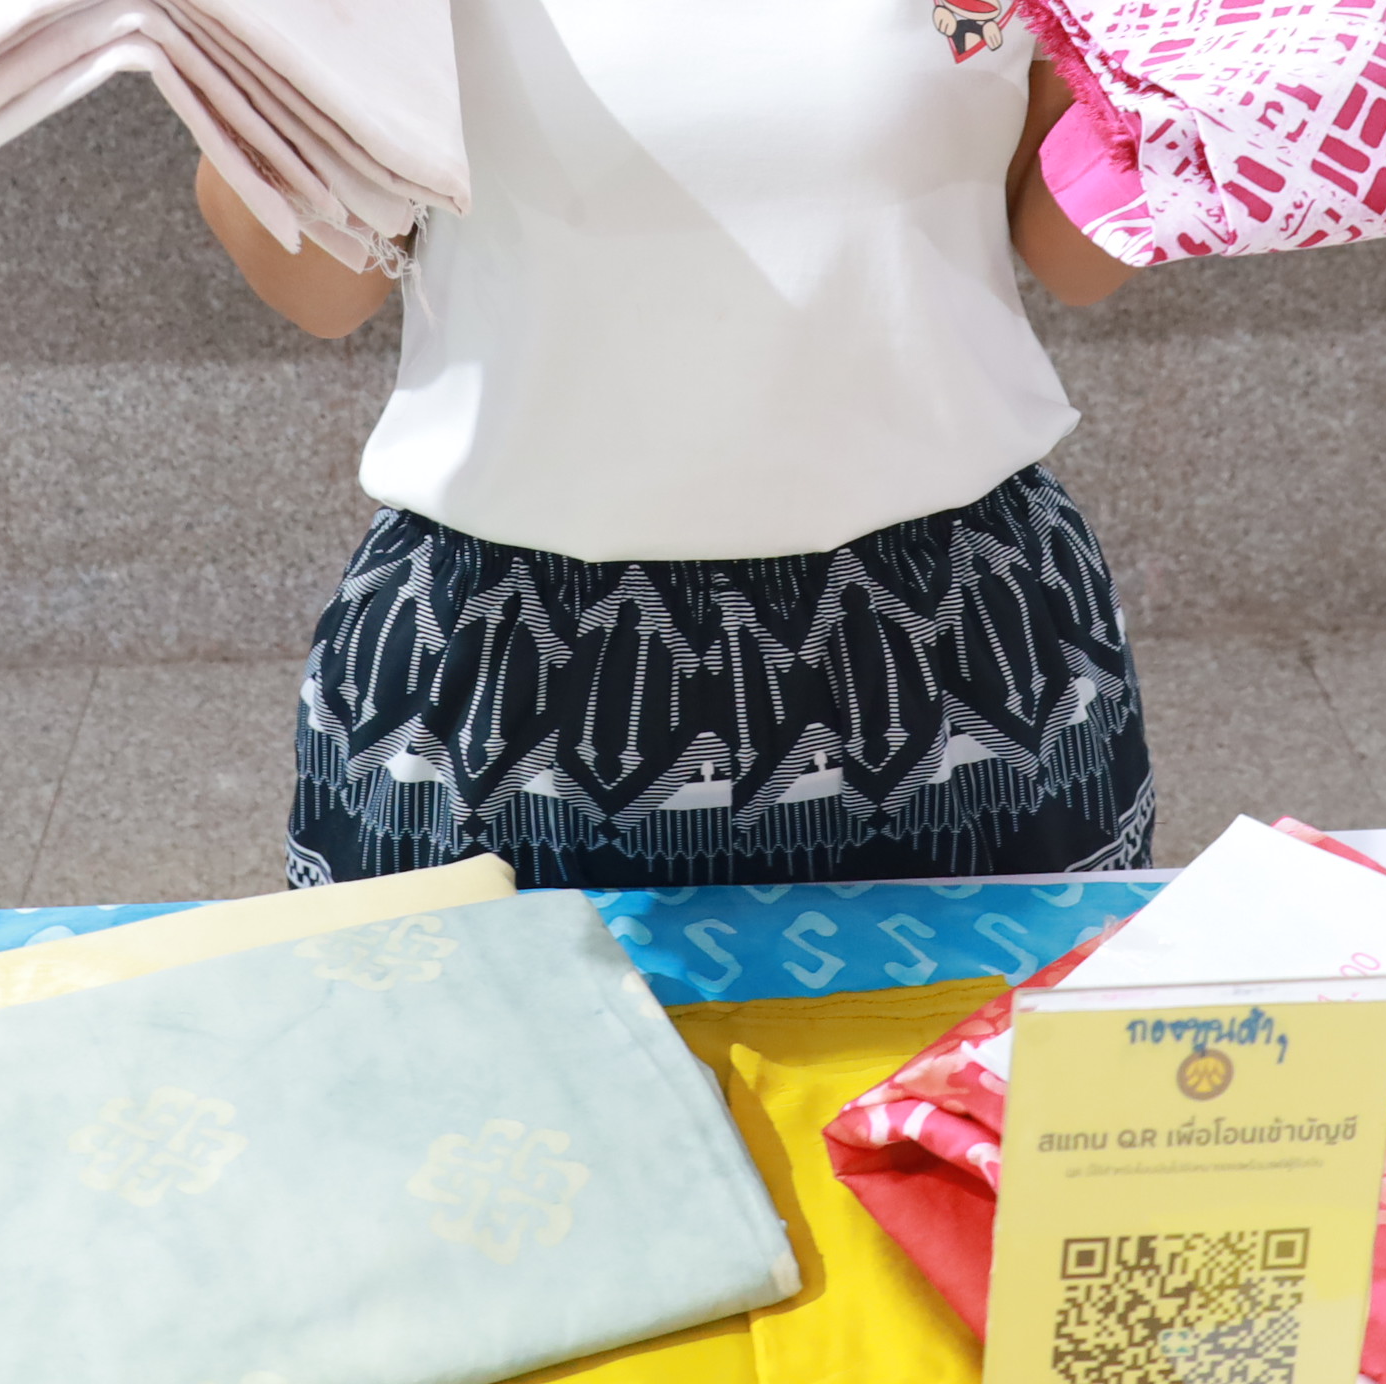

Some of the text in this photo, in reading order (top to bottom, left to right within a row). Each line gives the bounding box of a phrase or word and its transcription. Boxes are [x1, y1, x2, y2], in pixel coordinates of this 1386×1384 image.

[1038, 1115, 1358, 1153] สแกน QR เพื่อโอนเข้าบัญชี
